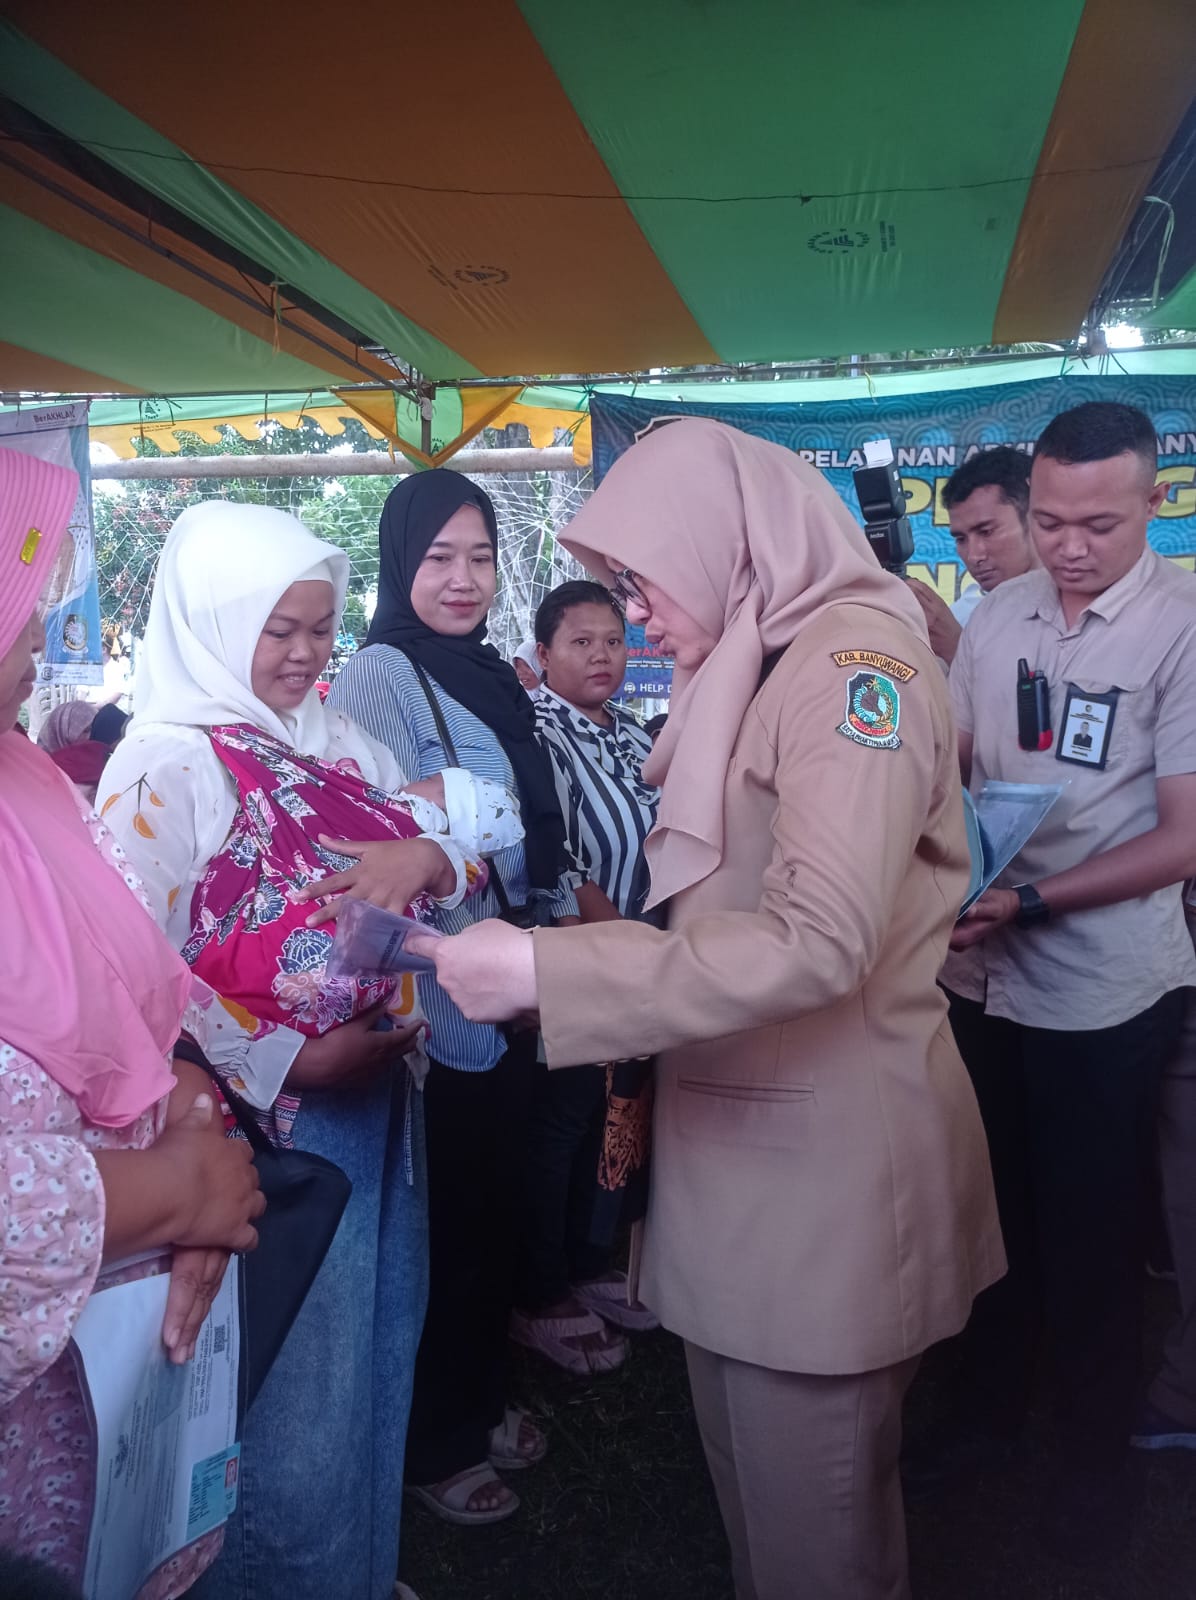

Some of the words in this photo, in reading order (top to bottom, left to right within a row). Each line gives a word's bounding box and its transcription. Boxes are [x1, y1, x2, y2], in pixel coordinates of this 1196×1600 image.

[800, 447, 955, 467] PELANAN
[836, 652, 858, 665] KAB.
[860, 652, 911, 679] BANYUWANGI
[640, 683, 664, 693] HELP
